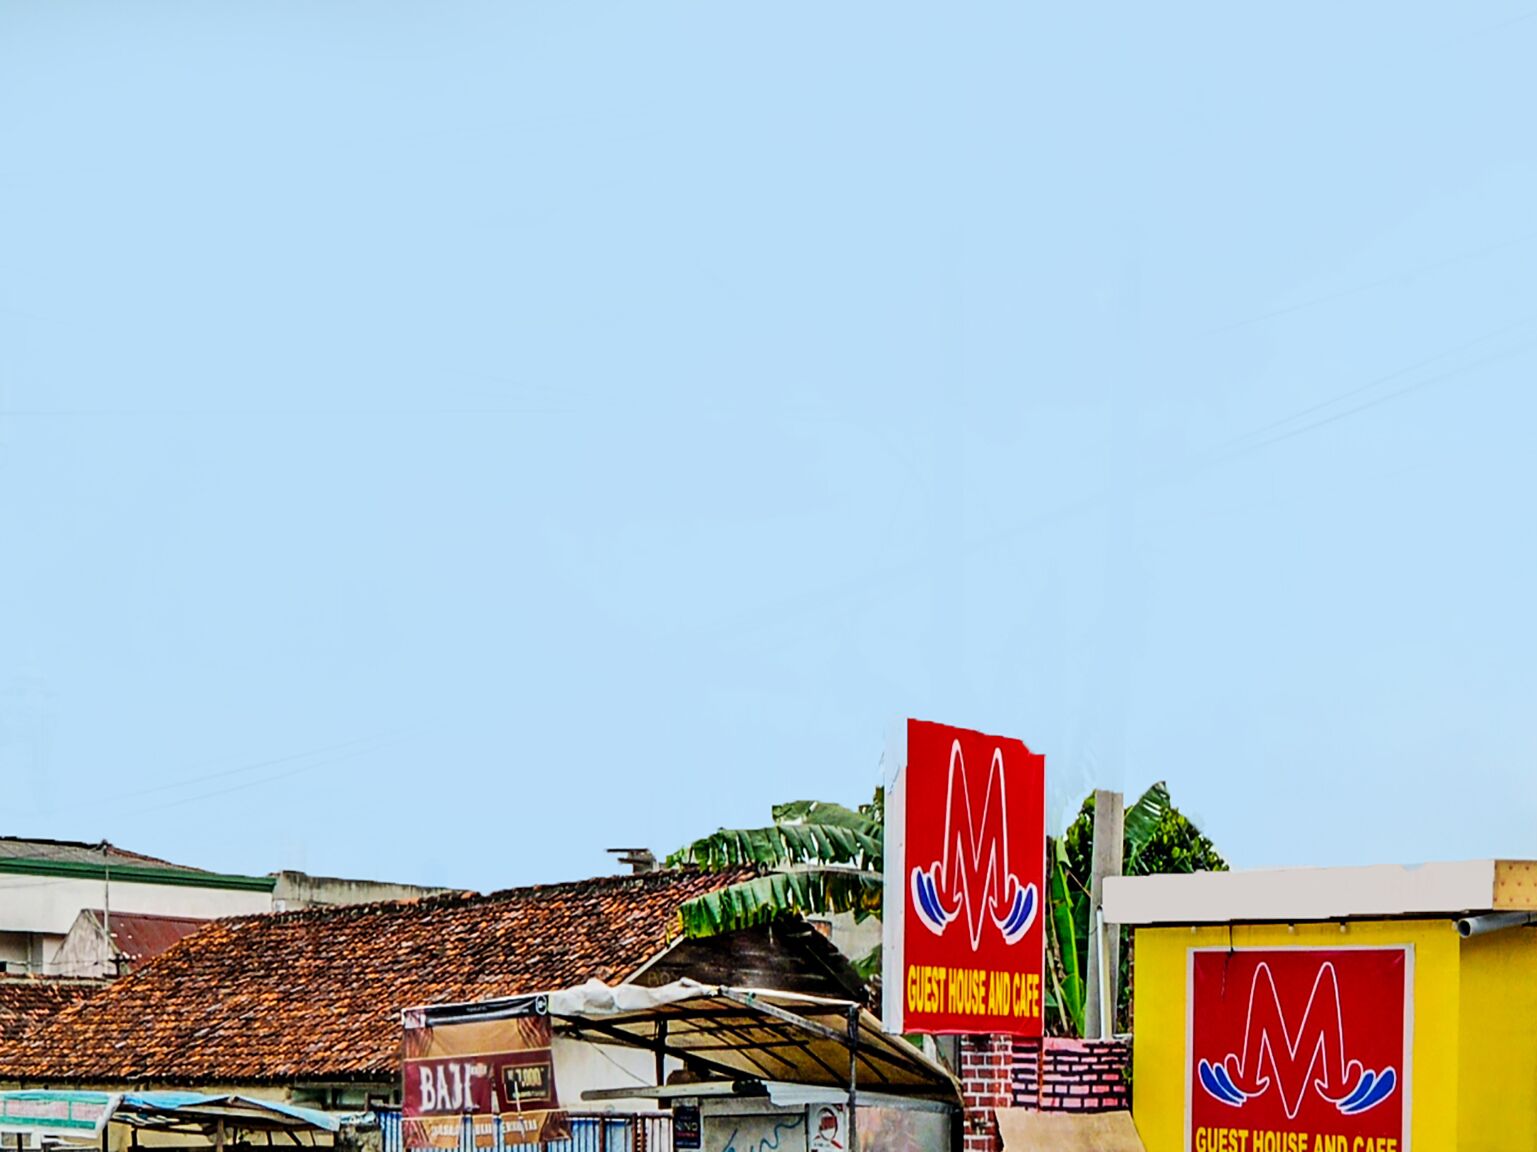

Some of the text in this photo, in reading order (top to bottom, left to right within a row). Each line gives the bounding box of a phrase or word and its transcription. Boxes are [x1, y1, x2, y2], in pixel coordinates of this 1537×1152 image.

[907, 964, 1040, 1018] GUEST HOUSE AND CAFE
